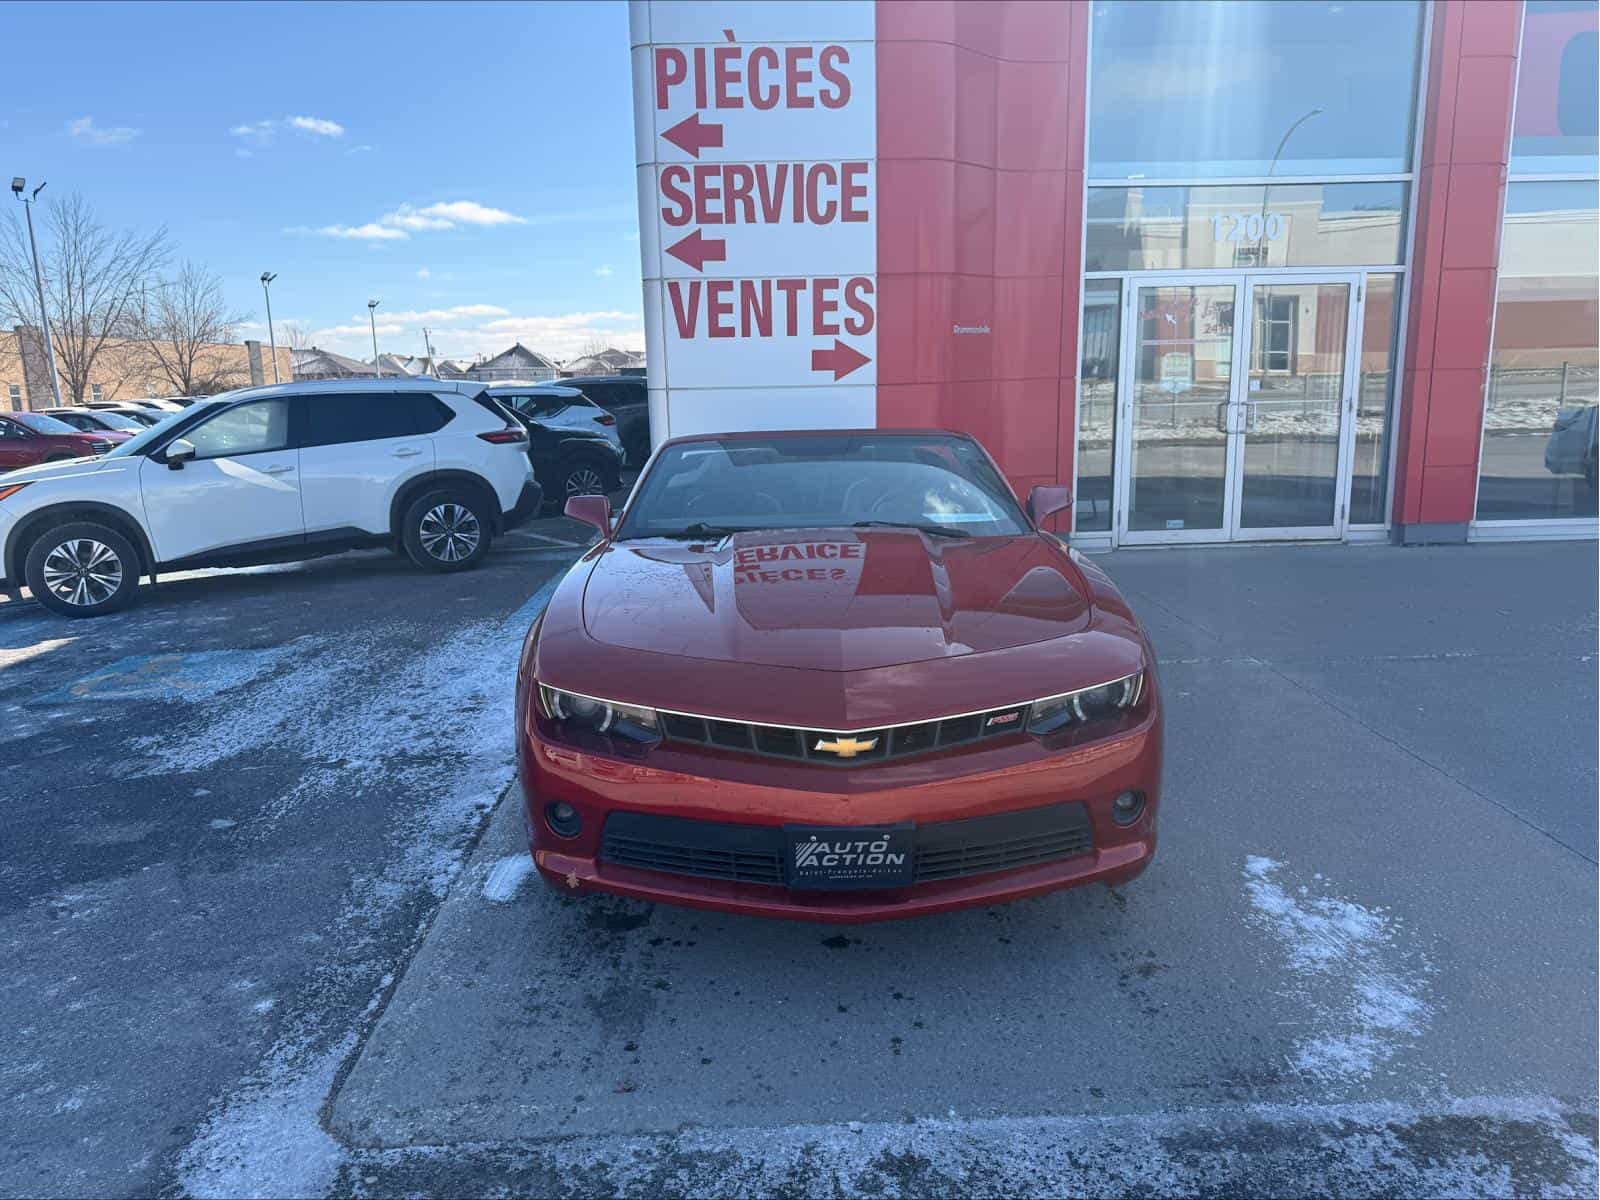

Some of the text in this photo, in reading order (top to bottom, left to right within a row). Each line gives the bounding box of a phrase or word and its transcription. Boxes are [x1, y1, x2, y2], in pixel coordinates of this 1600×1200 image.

[655, 29, 851, 110] PIÈCES
[660, 162, 869, 226] SERVICE
[1209, 213, 1284, 241] 1200
[668, 276, 875, 339] VENTES
[802, 854, 905, 866] ACTION
[814, 841, 888, 853] AUTO
